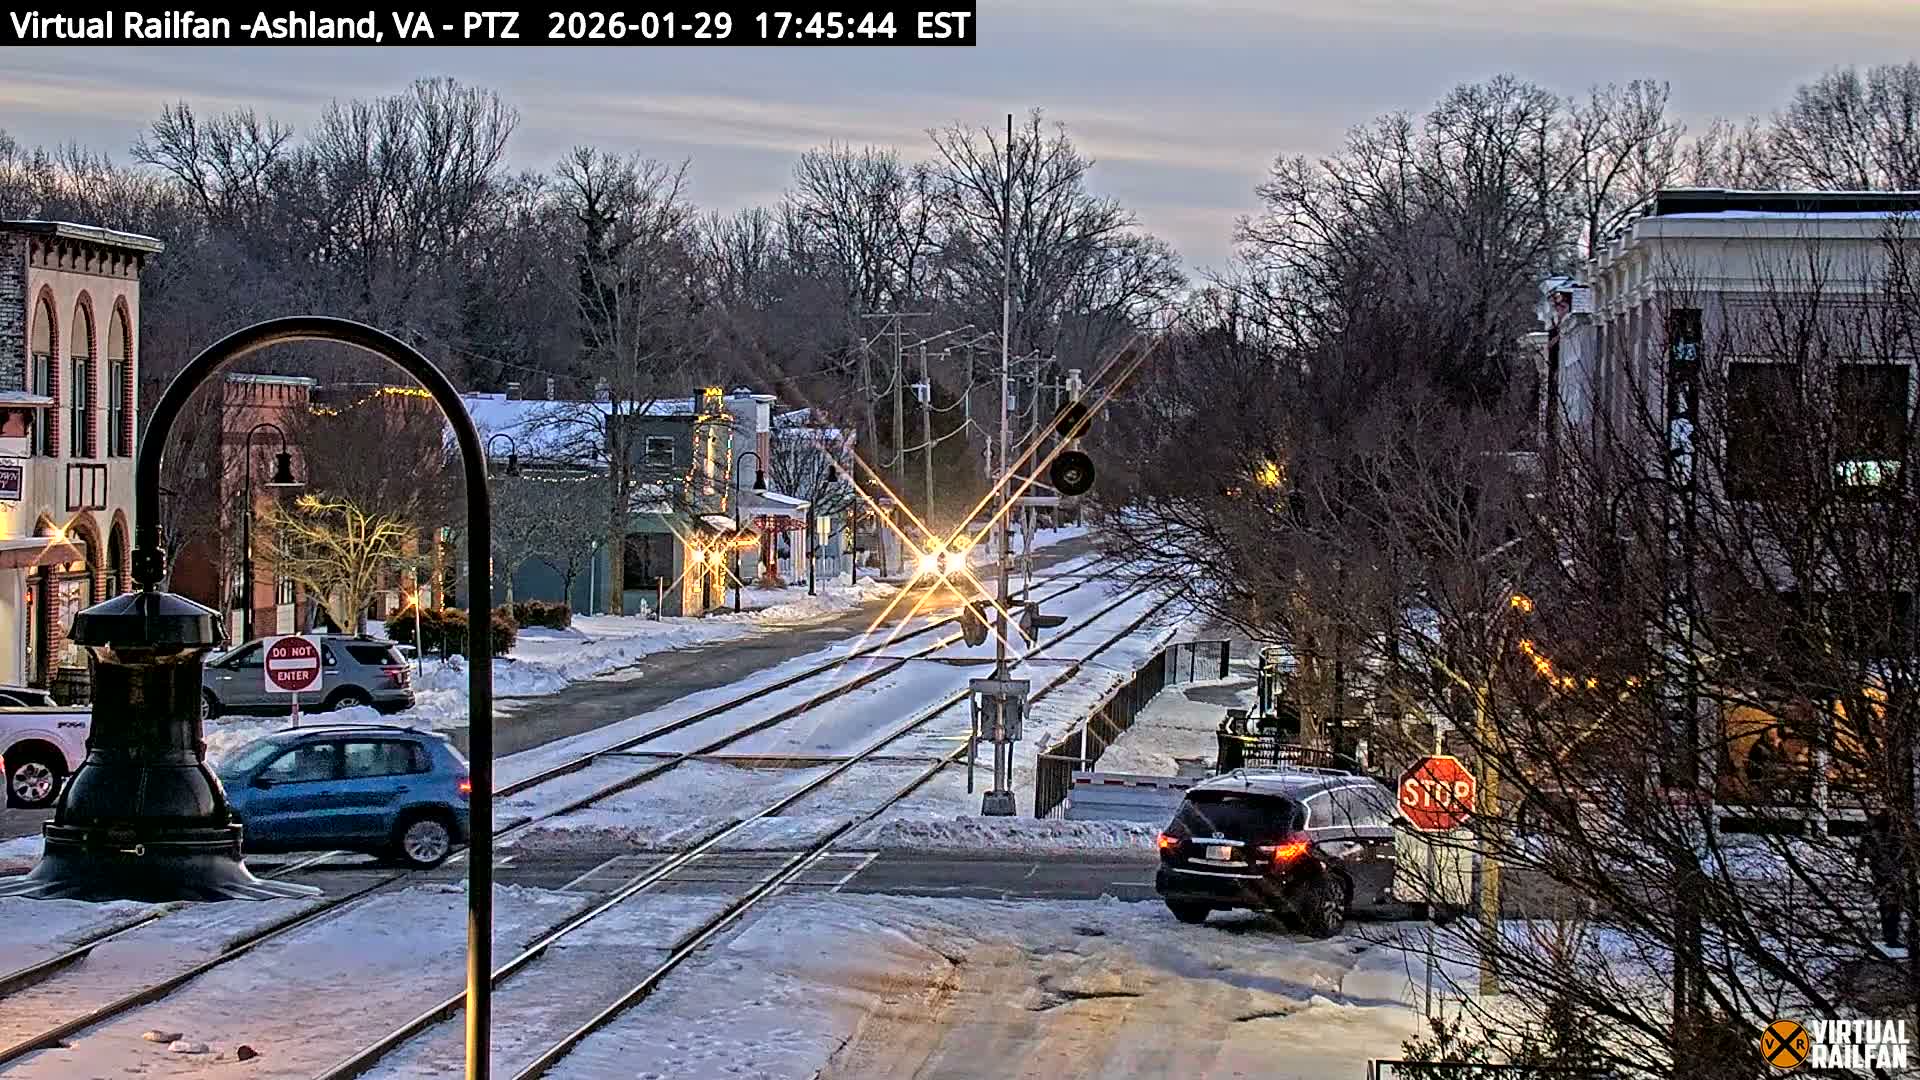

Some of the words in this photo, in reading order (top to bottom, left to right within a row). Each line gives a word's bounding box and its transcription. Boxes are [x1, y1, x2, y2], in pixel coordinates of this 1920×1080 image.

[272, 647, 287, 658] DO
[291, 646, 312, 657] NOT
[277, 671, 309, 681] ENTER
[1403, 778, 1470, 807] STOP
